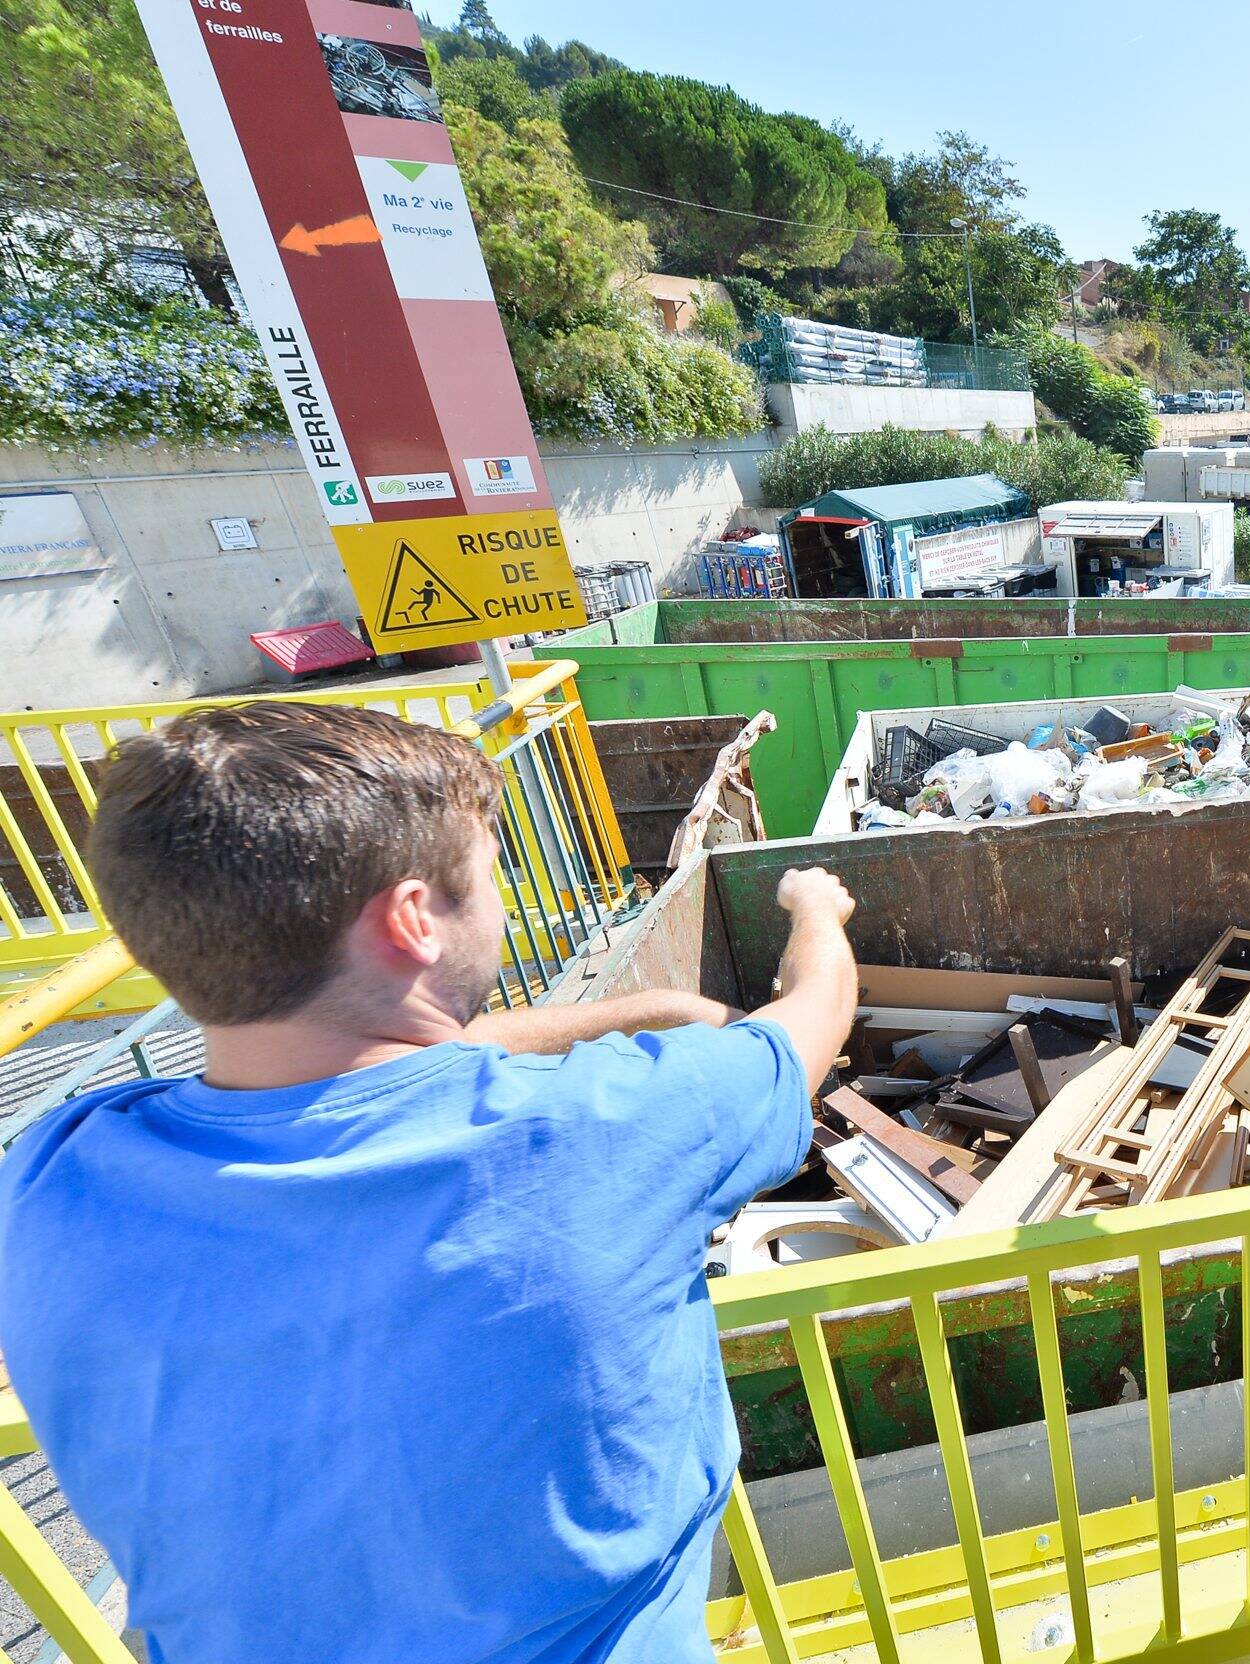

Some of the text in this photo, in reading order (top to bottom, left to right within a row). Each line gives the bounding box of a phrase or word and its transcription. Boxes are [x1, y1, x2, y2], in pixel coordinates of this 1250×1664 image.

[219, 0, 242, 13] de
[205, 20, 284, 44] ferrailles
[383, 194, 407, 207] Ma
[430, 198, 454, 210] vie
[392, 224, 453, 238] Recyclage
[268, 327, 340, 468] FERRAILLE
[457, 526, 561, 555] RISQUE
[500, 561, 539, 584] DE
[483, 589, 575, 619] CHUTE
